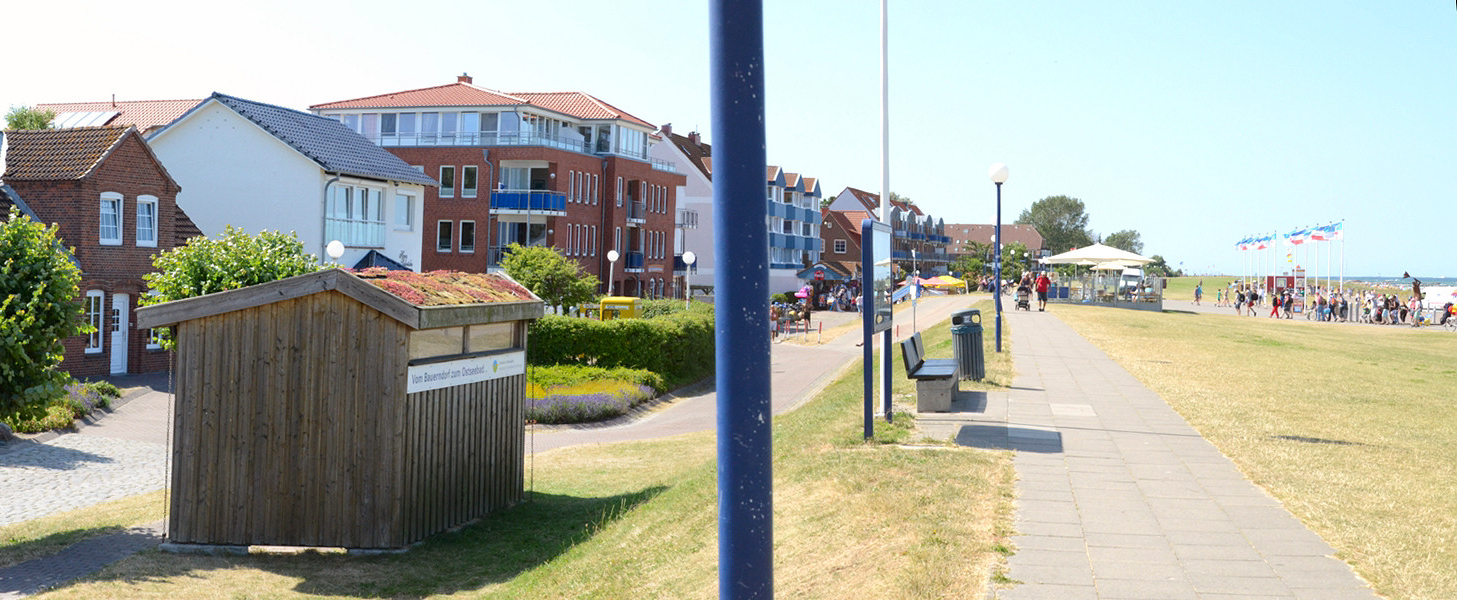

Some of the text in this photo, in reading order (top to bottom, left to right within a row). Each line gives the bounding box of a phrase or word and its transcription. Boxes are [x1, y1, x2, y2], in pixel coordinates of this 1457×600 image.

[412, 374, 423, 384] Vom
[424, 371, 450, 382] Bauerndorf
[451, 370, 461, 378] zum
